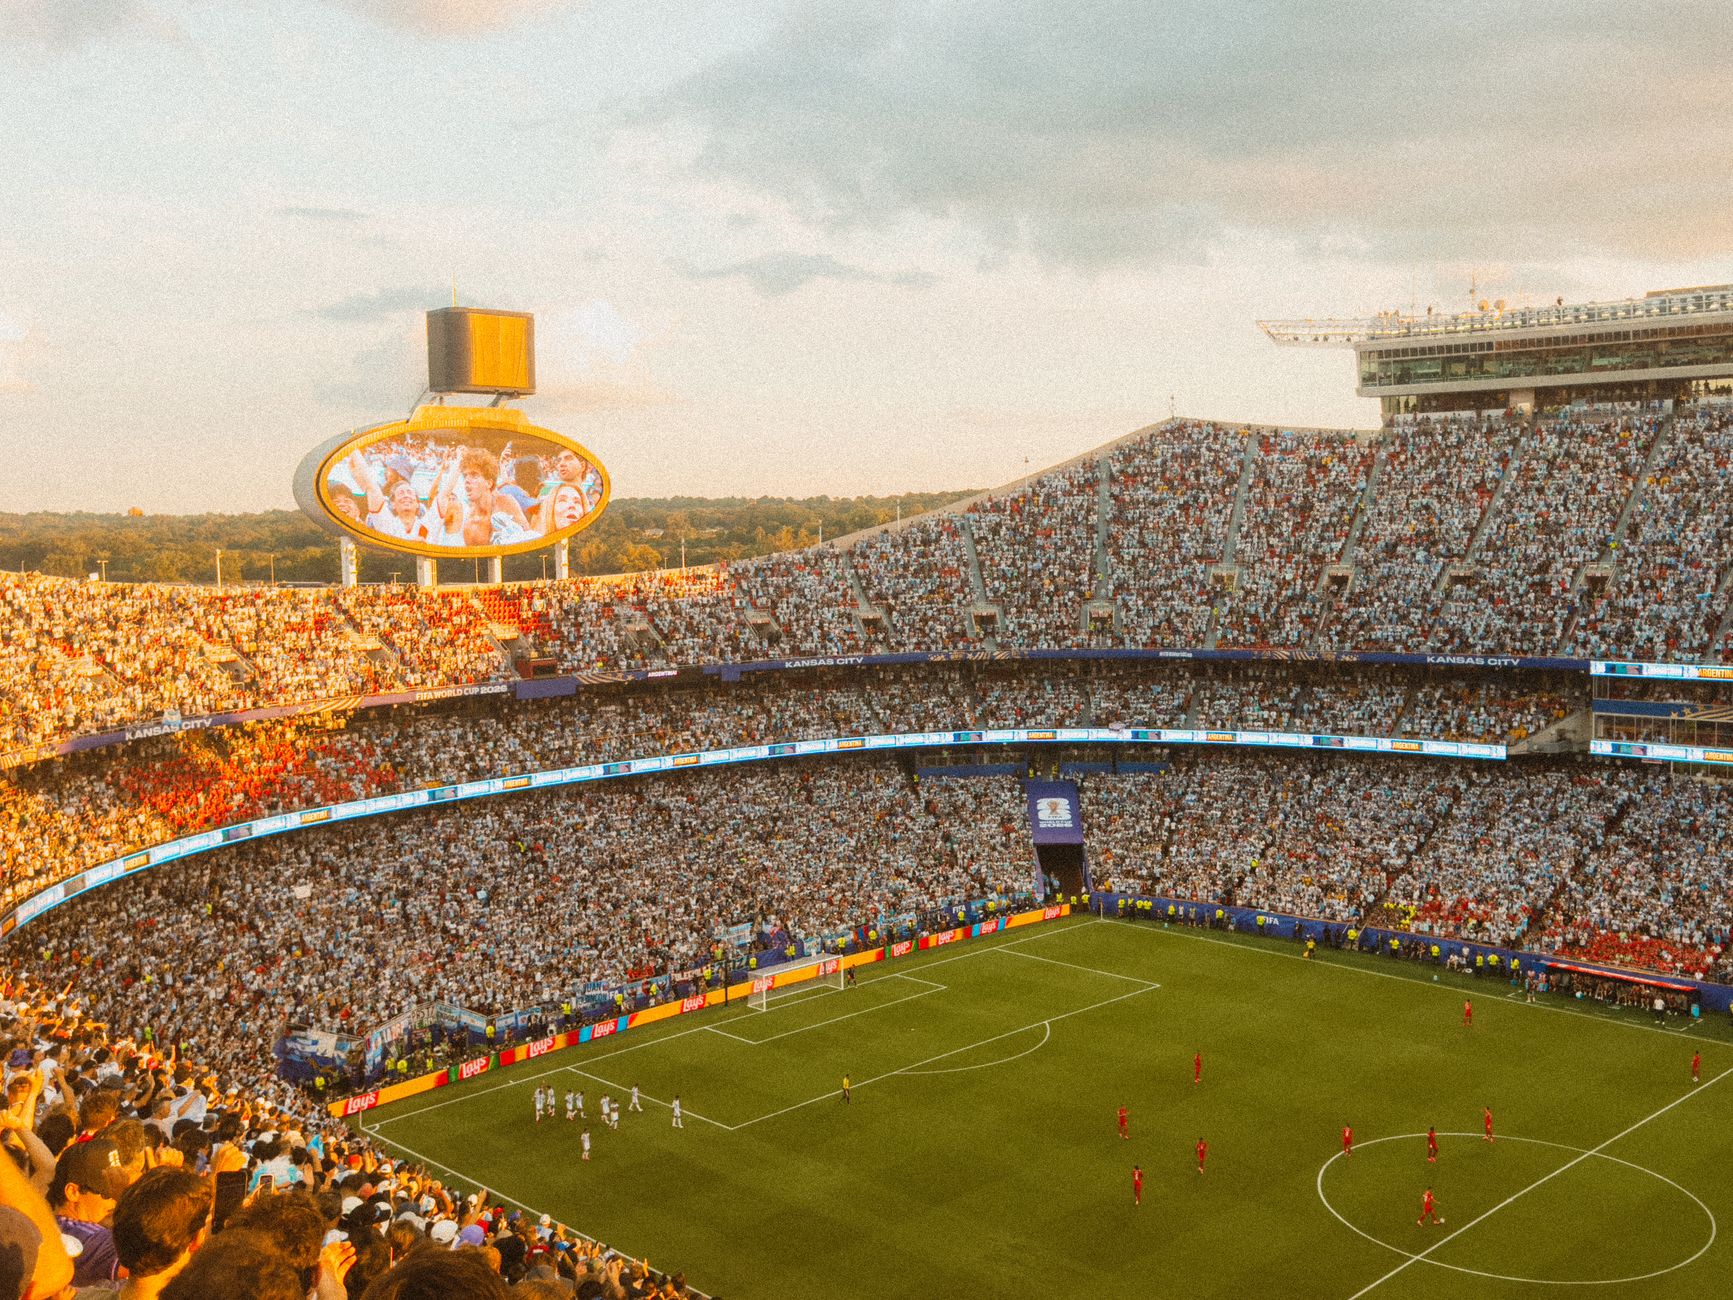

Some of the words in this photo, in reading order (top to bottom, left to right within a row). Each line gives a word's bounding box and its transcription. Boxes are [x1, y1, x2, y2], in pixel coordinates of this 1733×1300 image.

[785, 659, 834, 668] KANSAS
[836, 657, 864, 666] CITY
[1426, 656, 1484, 665] KANSAS
[1487, 658, 1520, 666] CITY
[415, 692, 433, 701] FIFA
[433, 688, 463, 699] WORLD
[463, 687, 480, 696] CUP
[480, 684, 508, 695] 2026
[125, 725, 179, 741] KANSAS
[181, 718, 212, 731] CITY
[952, 905, 966, 914] FIFA
